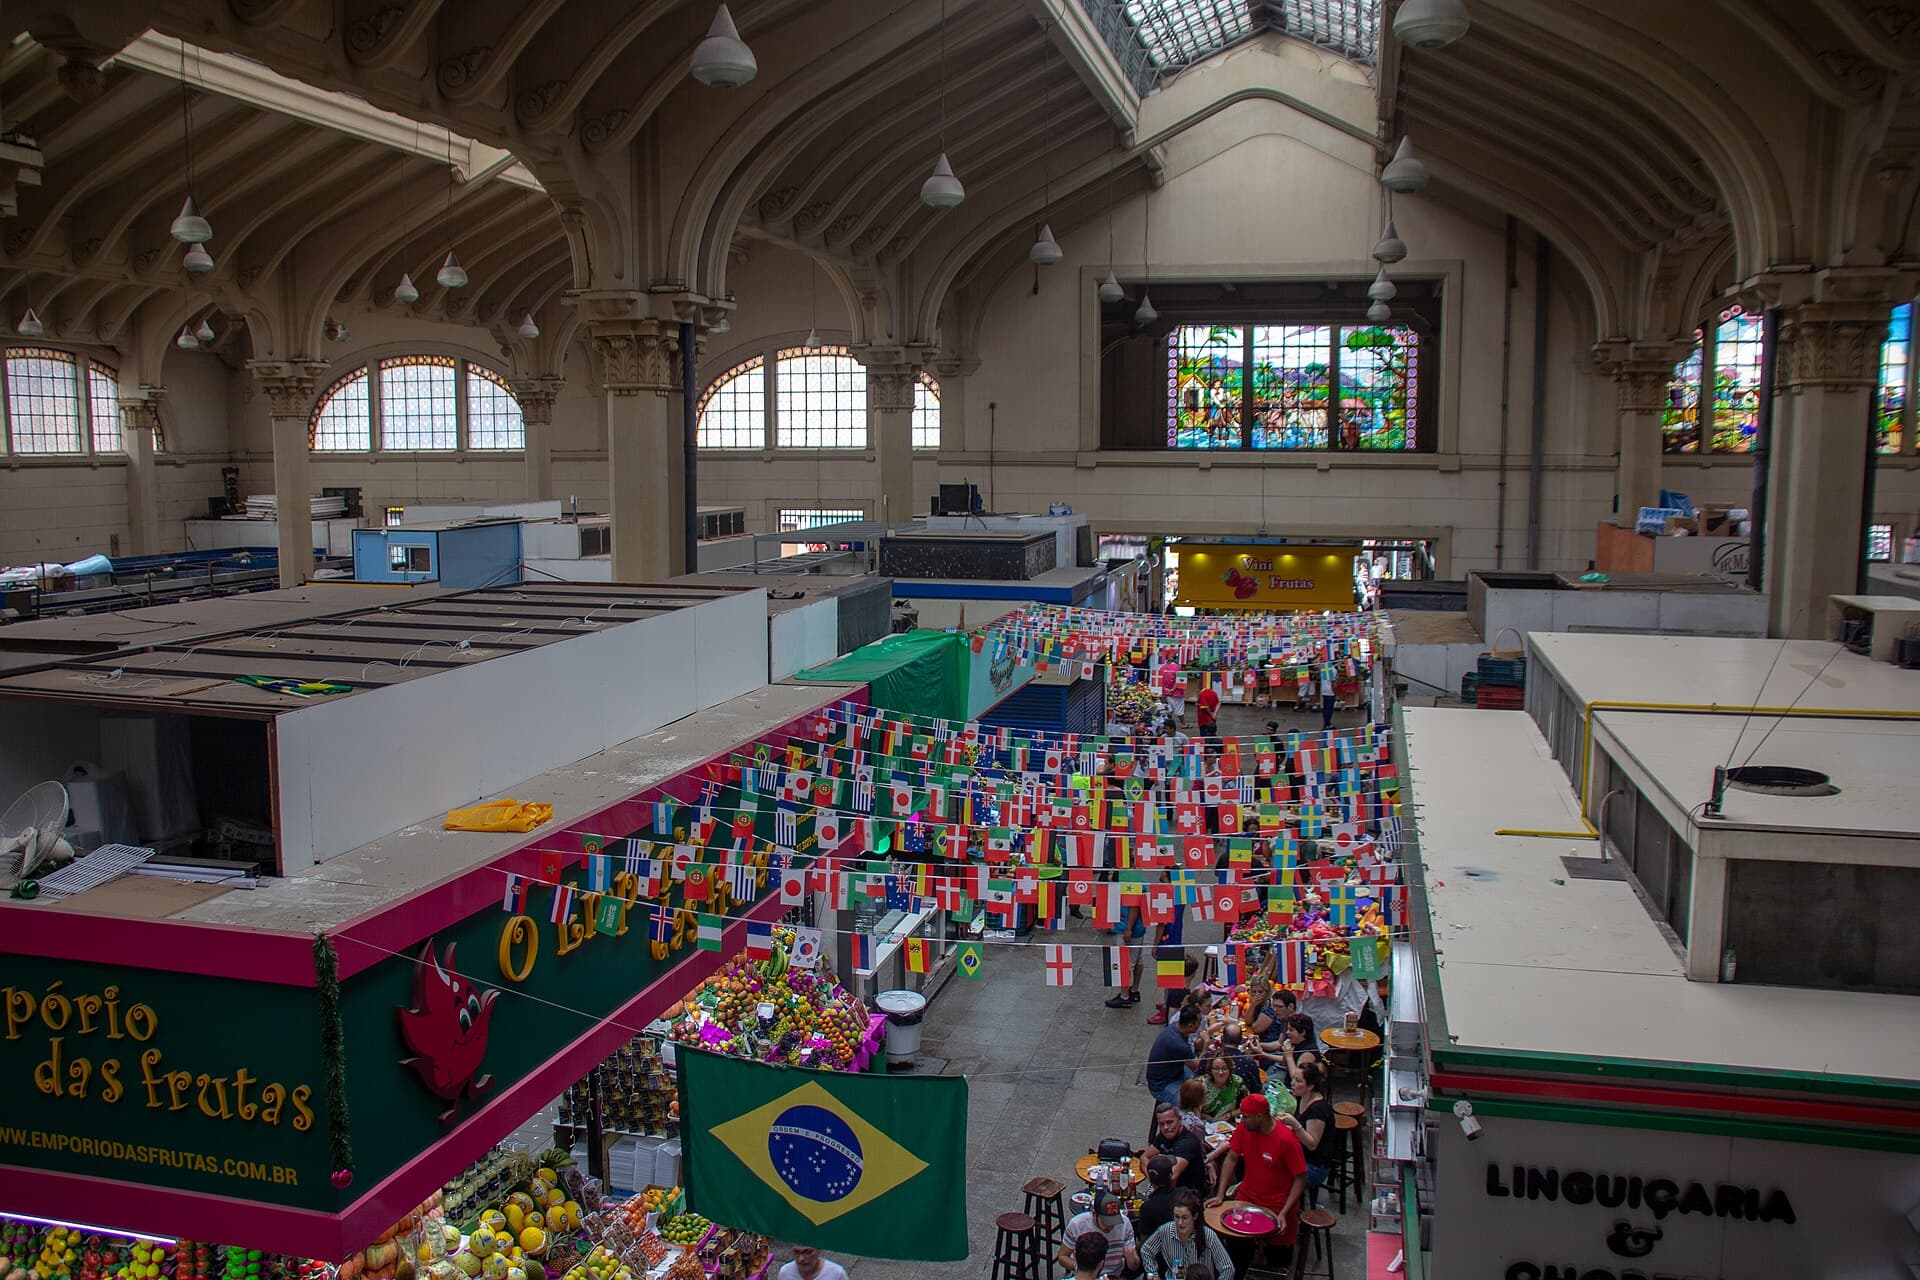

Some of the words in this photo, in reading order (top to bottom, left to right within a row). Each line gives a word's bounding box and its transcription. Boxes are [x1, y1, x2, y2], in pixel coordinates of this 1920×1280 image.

[1242, 557, 1273, 570] Vini
[1270, 575, 1314, 589] Frutas
[0, 980, 159, 1042] pório
[33, 1036, 125, 1104] das
[141, 1048, 315, 1132] frutas
[773, 1126, 800, 1134] ORDEM
[815, 1132, 861, 1164] PROGRESSO
[1487, 1162, 1797, 1225] LINGUIÇARIA
[1606, 1219, 1663, 1258] &
